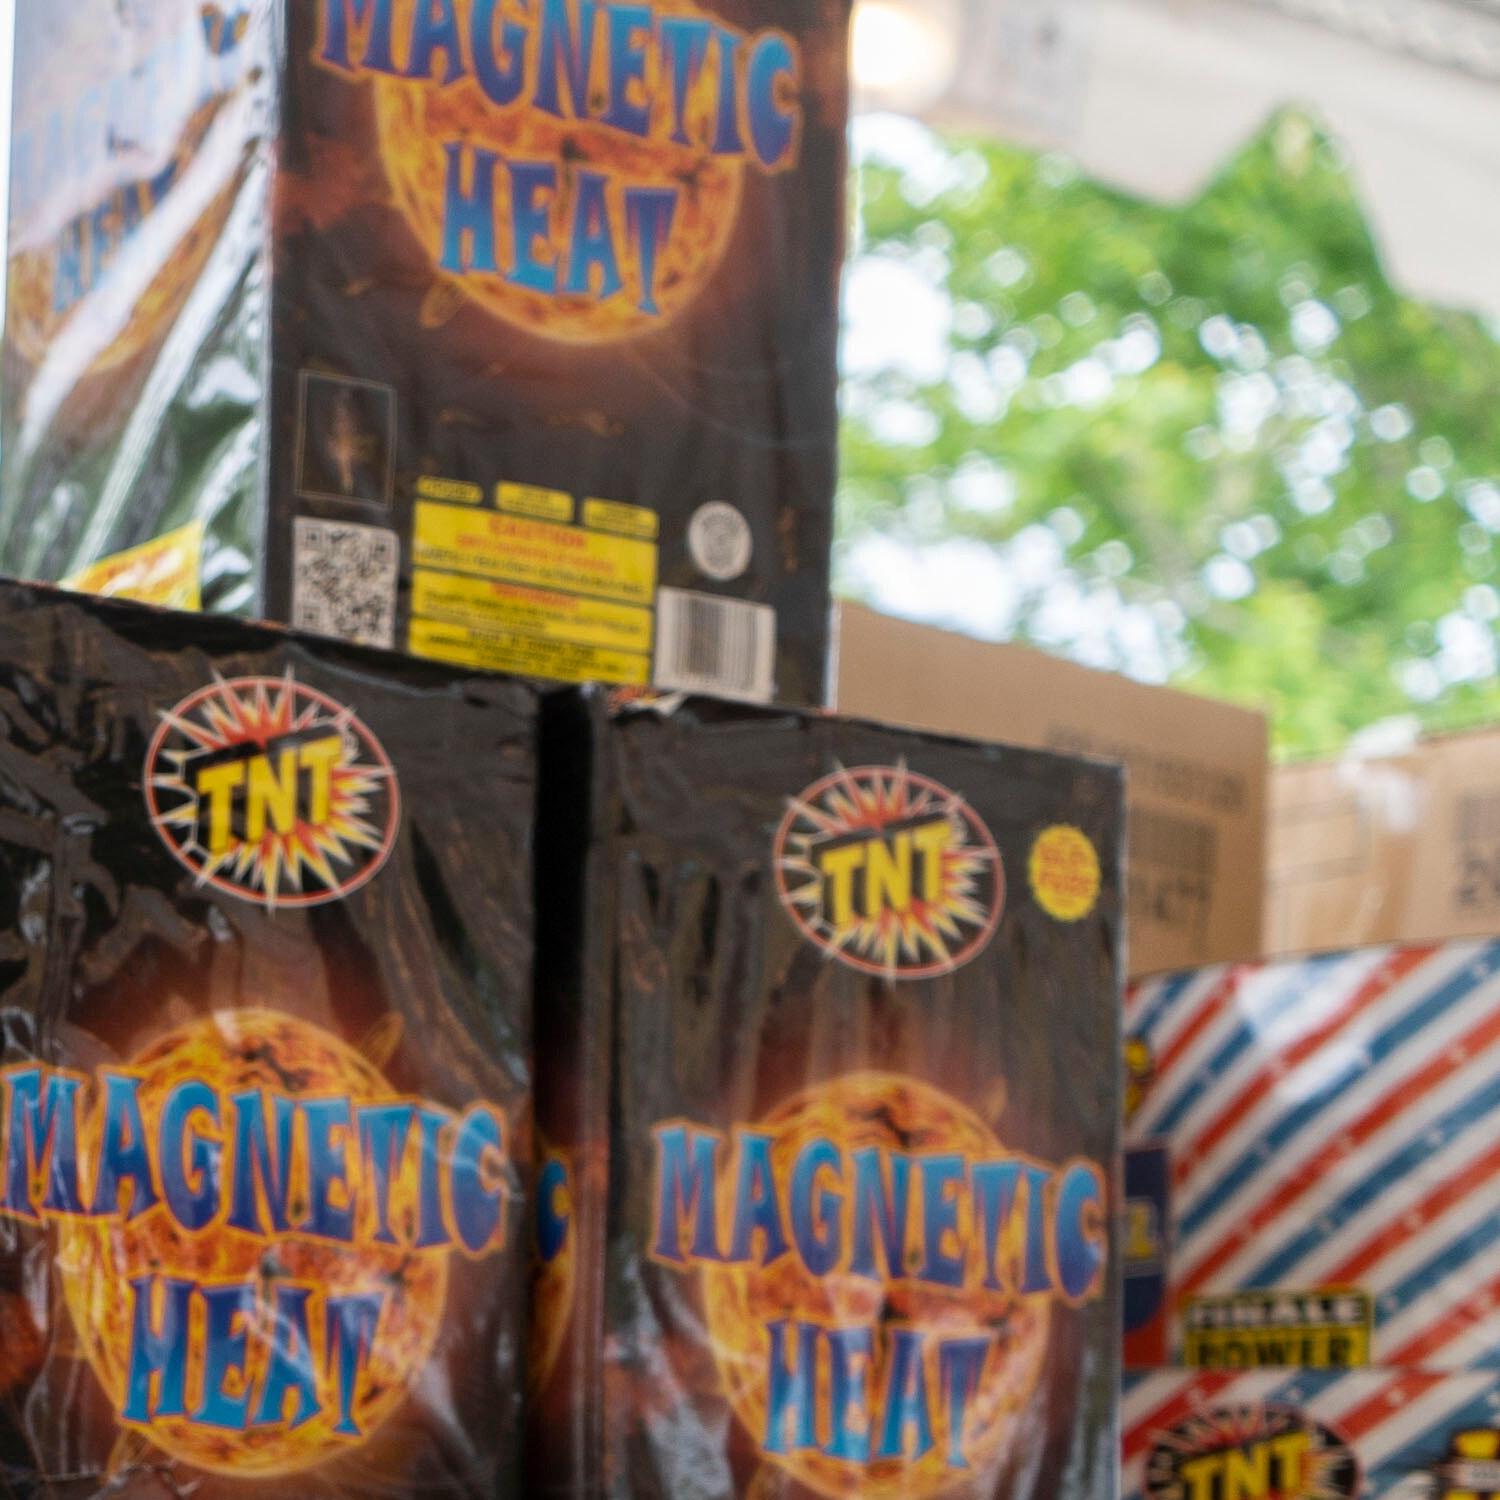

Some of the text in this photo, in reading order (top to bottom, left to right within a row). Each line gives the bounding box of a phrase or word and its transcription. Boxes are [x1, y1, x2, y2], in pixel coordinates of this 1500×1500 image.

[440, 142, 679, 315] HEAT
[198, 732, 343, 856] TNT
[821, 820, 956, 926] TNT
[654, 1124, 1102, 1300] MAGNETIC
[123, 1277, 393, 1437] HEAT
[763, 1320, 994, 1468] HEAT
